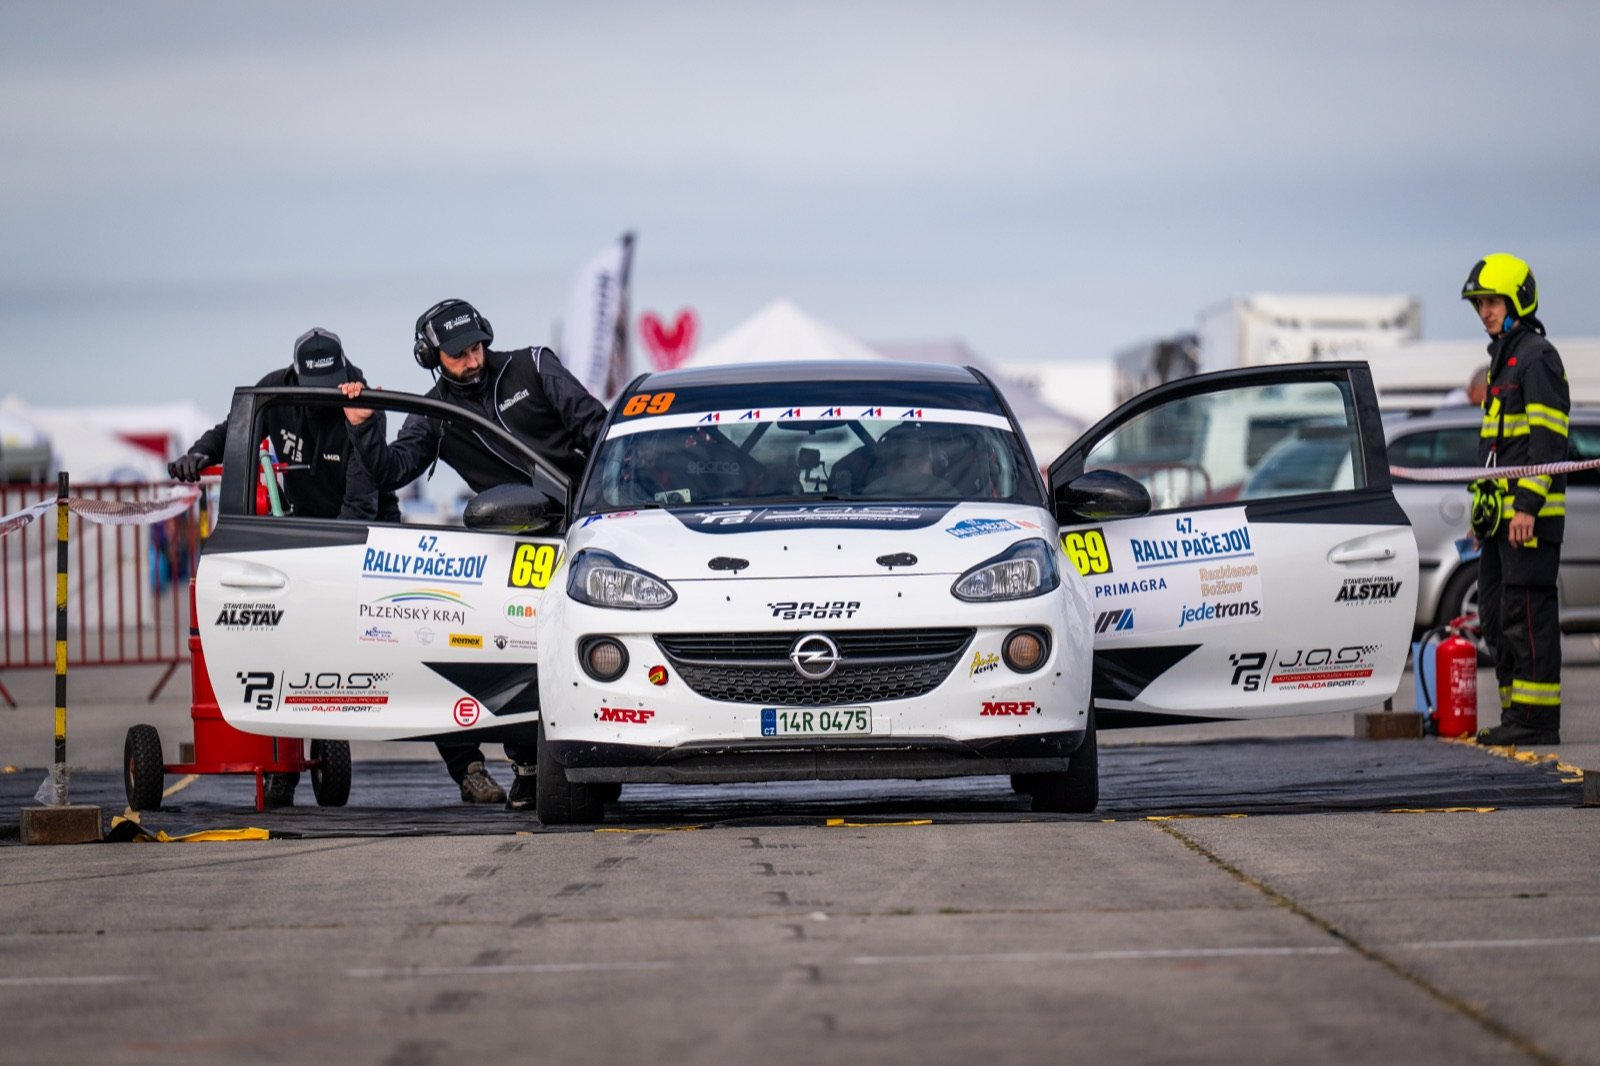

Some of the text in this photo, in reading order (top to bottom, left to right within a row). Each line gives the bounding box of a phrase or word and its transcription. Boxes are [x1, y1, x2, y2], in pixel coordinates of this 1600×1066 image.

[623, 392, 676, 416] 69
[780, 408, 800, 417] A1
[820, 407, 841, 417] A1
[860, 407, 881, 416] A1
[699, 412, 720, 422] A1
[739, 410, 760, 420] A1
[901, 409, 922, 418] A1
[1176, 517, 1199, 534] 47.
[418, 535, 439, 553] 47.
[1130, 526, 1252, 563] RALLY PAČEJOV
[1064, 530, 1110, 576] 69
[363, 547, 488, 579] RALLY PAČEJOV
[511, 544, 555, 588] 69
[1200, 564, 1259, 582] Rezidence
[1095, 578, 1167, 598] PRIMAGRA
[1201, 580, 1243, 597] Božkov
[1334, 581, 1403, 603] ALSTAV
[360, 604, 465, 626] PLZEŇSKÝ KRAJ
[767, 601, 861, 617] PAJDA
[783, 609, 857, 621] SPORT
[214, 609, 285, 627] ALSTAV
[969, 651, 999, 678] Auto
[974, 662, 998, 674] design
[600, 707, 655, 724] MRF
[980, 701, 1036, 716] MRF
[779, 711, 867, 732] 14R 0475
[764, 727, 775, 736] CZ
